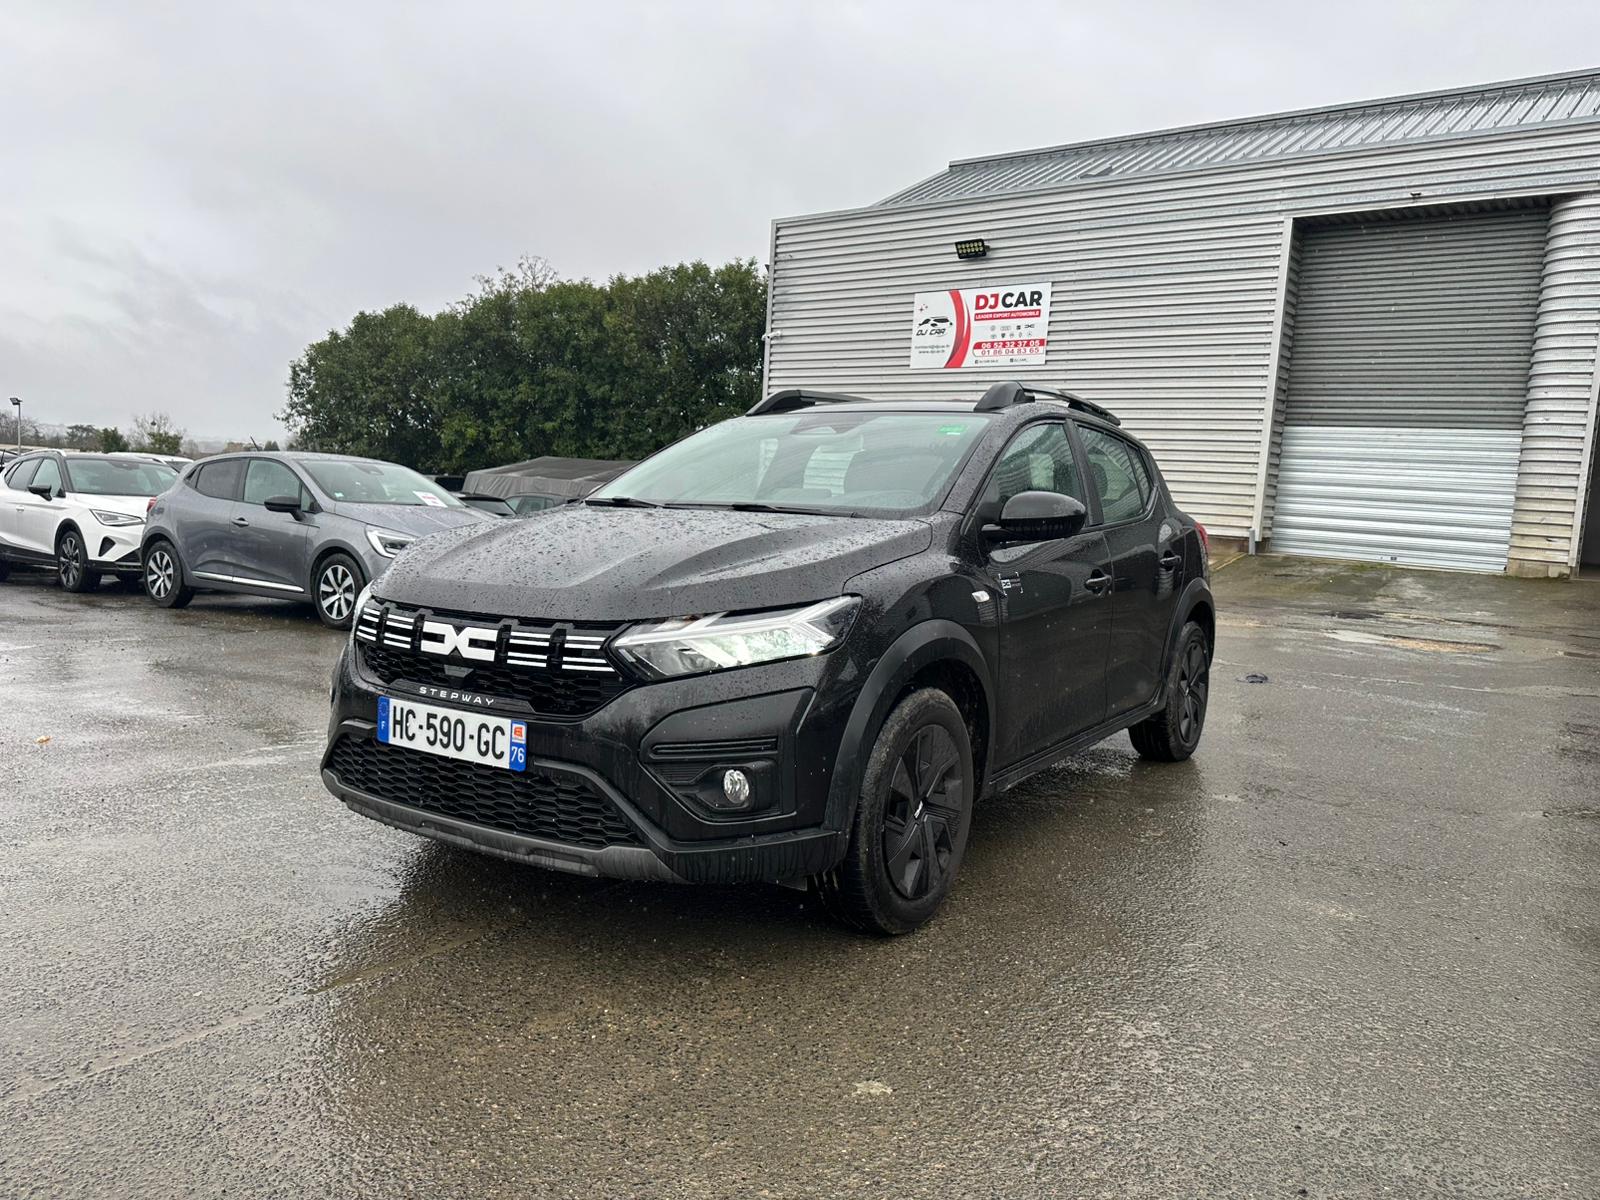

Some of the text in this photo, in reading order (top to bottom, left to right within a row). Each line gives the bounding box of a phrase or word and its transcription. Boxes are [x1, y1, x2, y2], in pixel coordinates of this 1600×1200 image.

[975, 291, 1042, 310] DJ CAR
[929, 328, 946, 336] CAR
[418, 685, 495, 706] STEPWAY
[380, 720, 386, 730] F
[392, 705, 506, 760] HC-590-GC
[511, 745, 525, 764] 76
